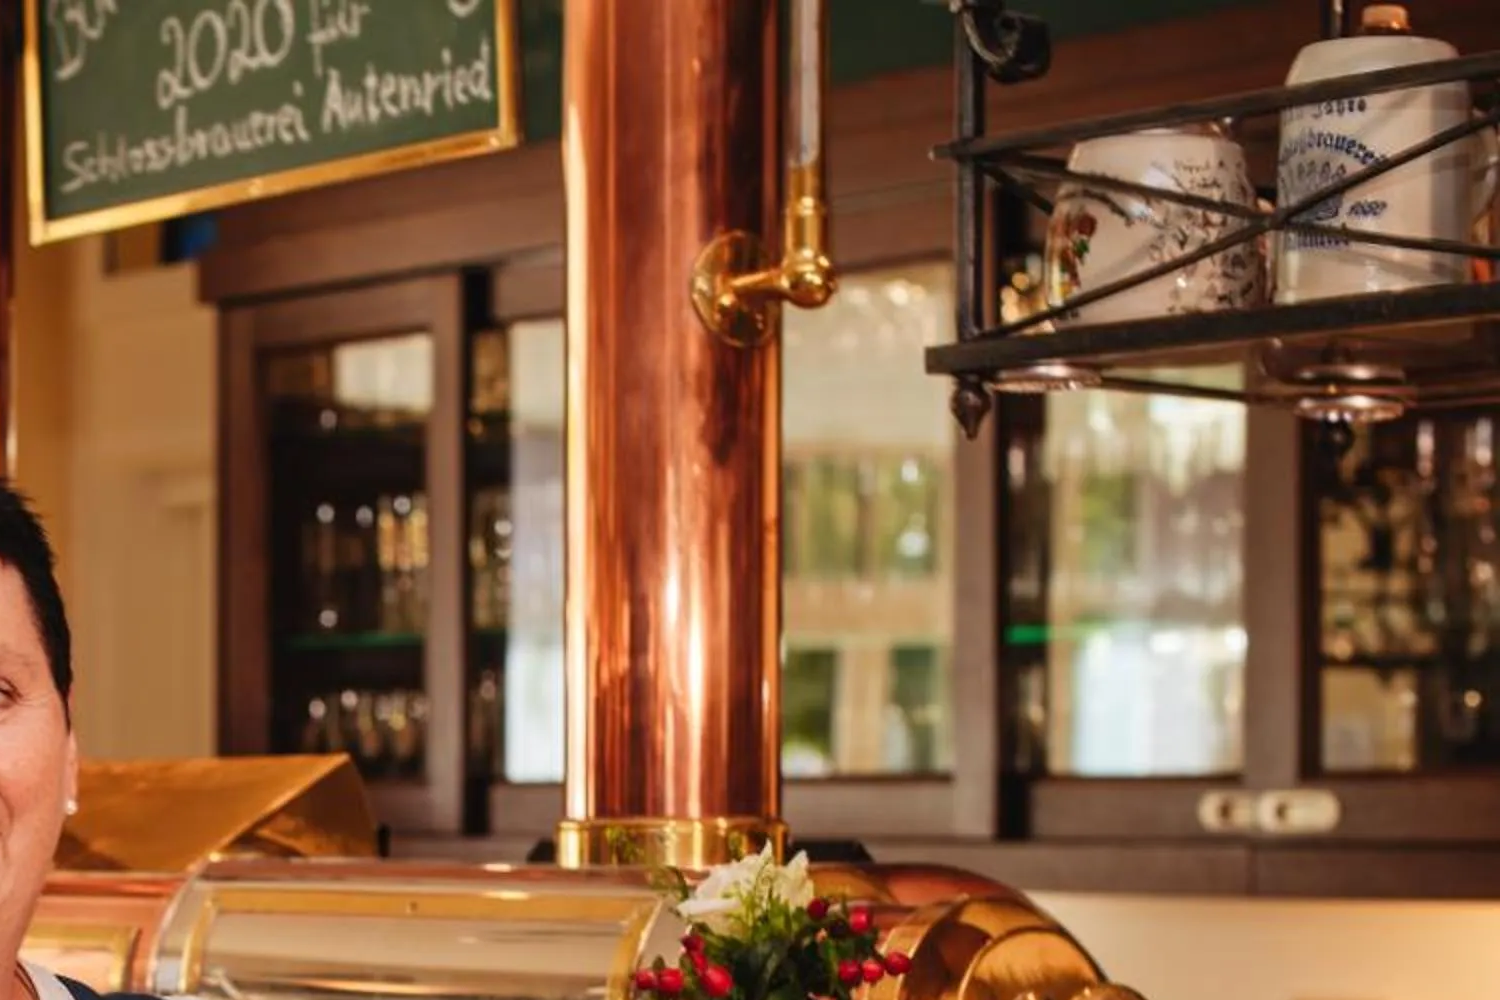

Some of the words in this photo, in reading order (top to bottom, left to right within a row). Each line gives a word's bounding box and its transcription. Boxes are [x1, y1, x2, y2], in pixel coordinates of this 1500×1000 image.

[60, 79, 311, 193] Schlossbrauerei
[320, 35, 493, 134] Autenried
[155, 0, 295, 110] 2020
